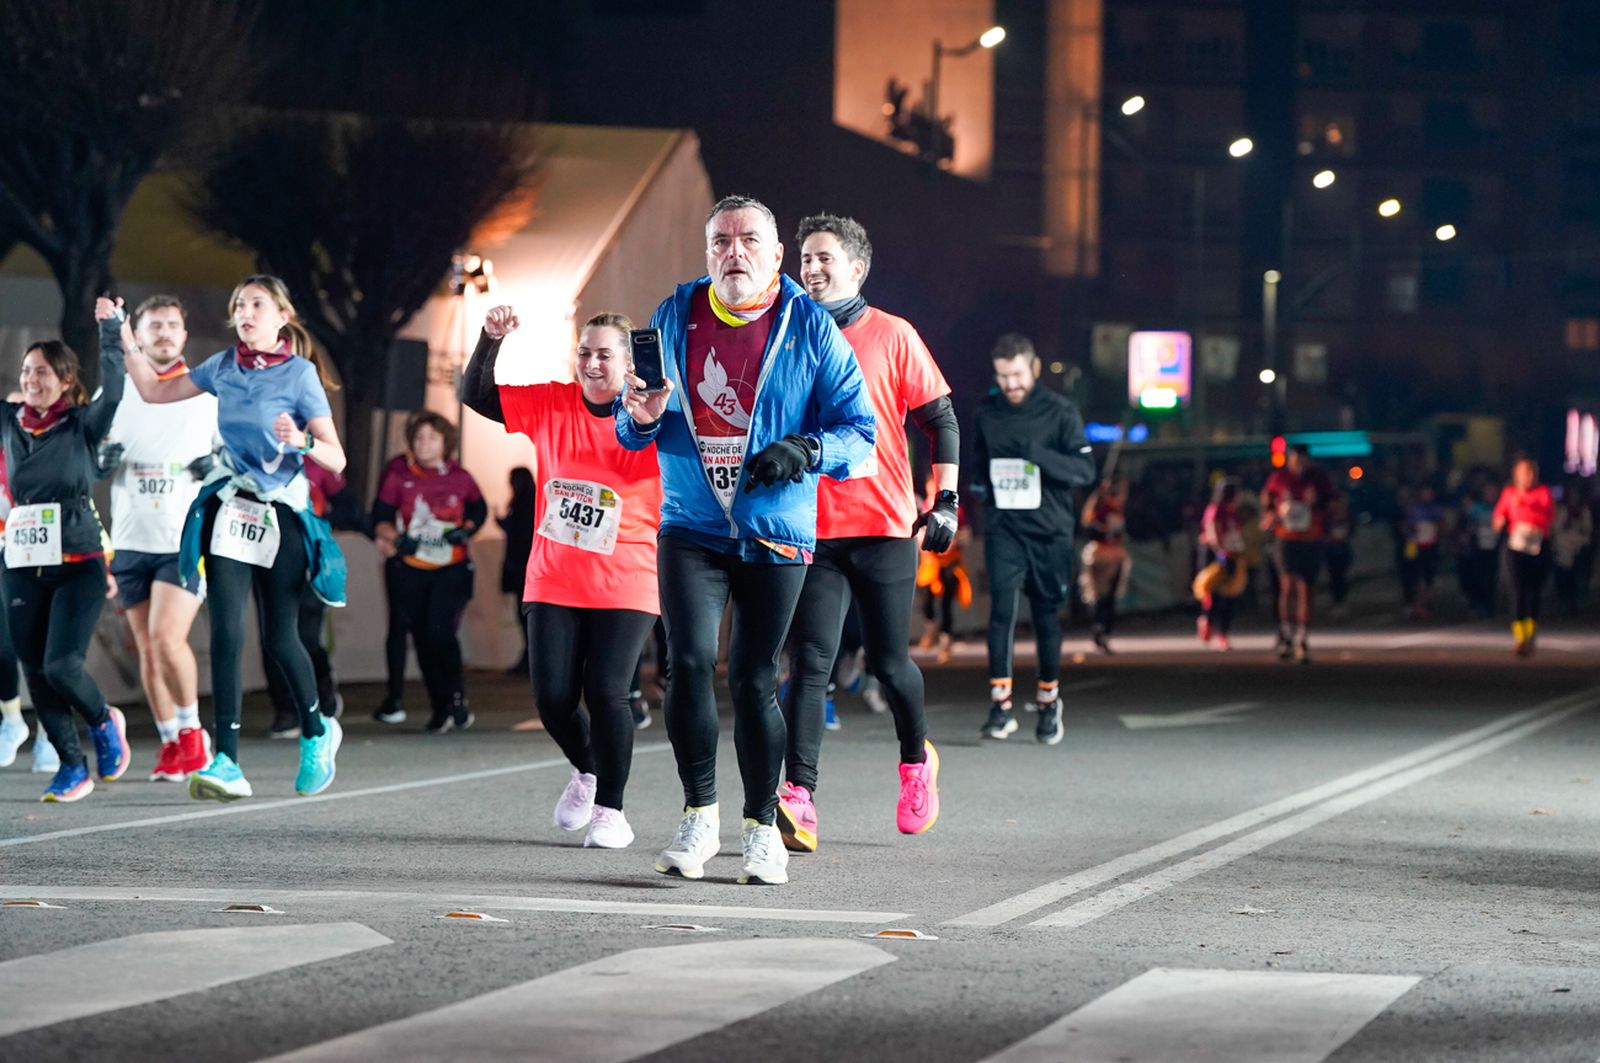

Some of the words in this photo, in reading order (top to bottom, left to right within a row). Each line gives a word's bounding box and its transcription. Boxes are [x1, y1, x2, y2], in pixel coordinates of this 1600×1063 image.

[713, 392, 736, 416] 43
[706, 445, 731, 454] NOCHE
[731, 445, 743, 454] DE
[703, 455, 714, 465] AN
[137, 478, 175, 494] 3027
[559, 497, 605, 528] 5437
[13, 526, 48, 546] 4583
[229, 519, 266, 543] 6167
